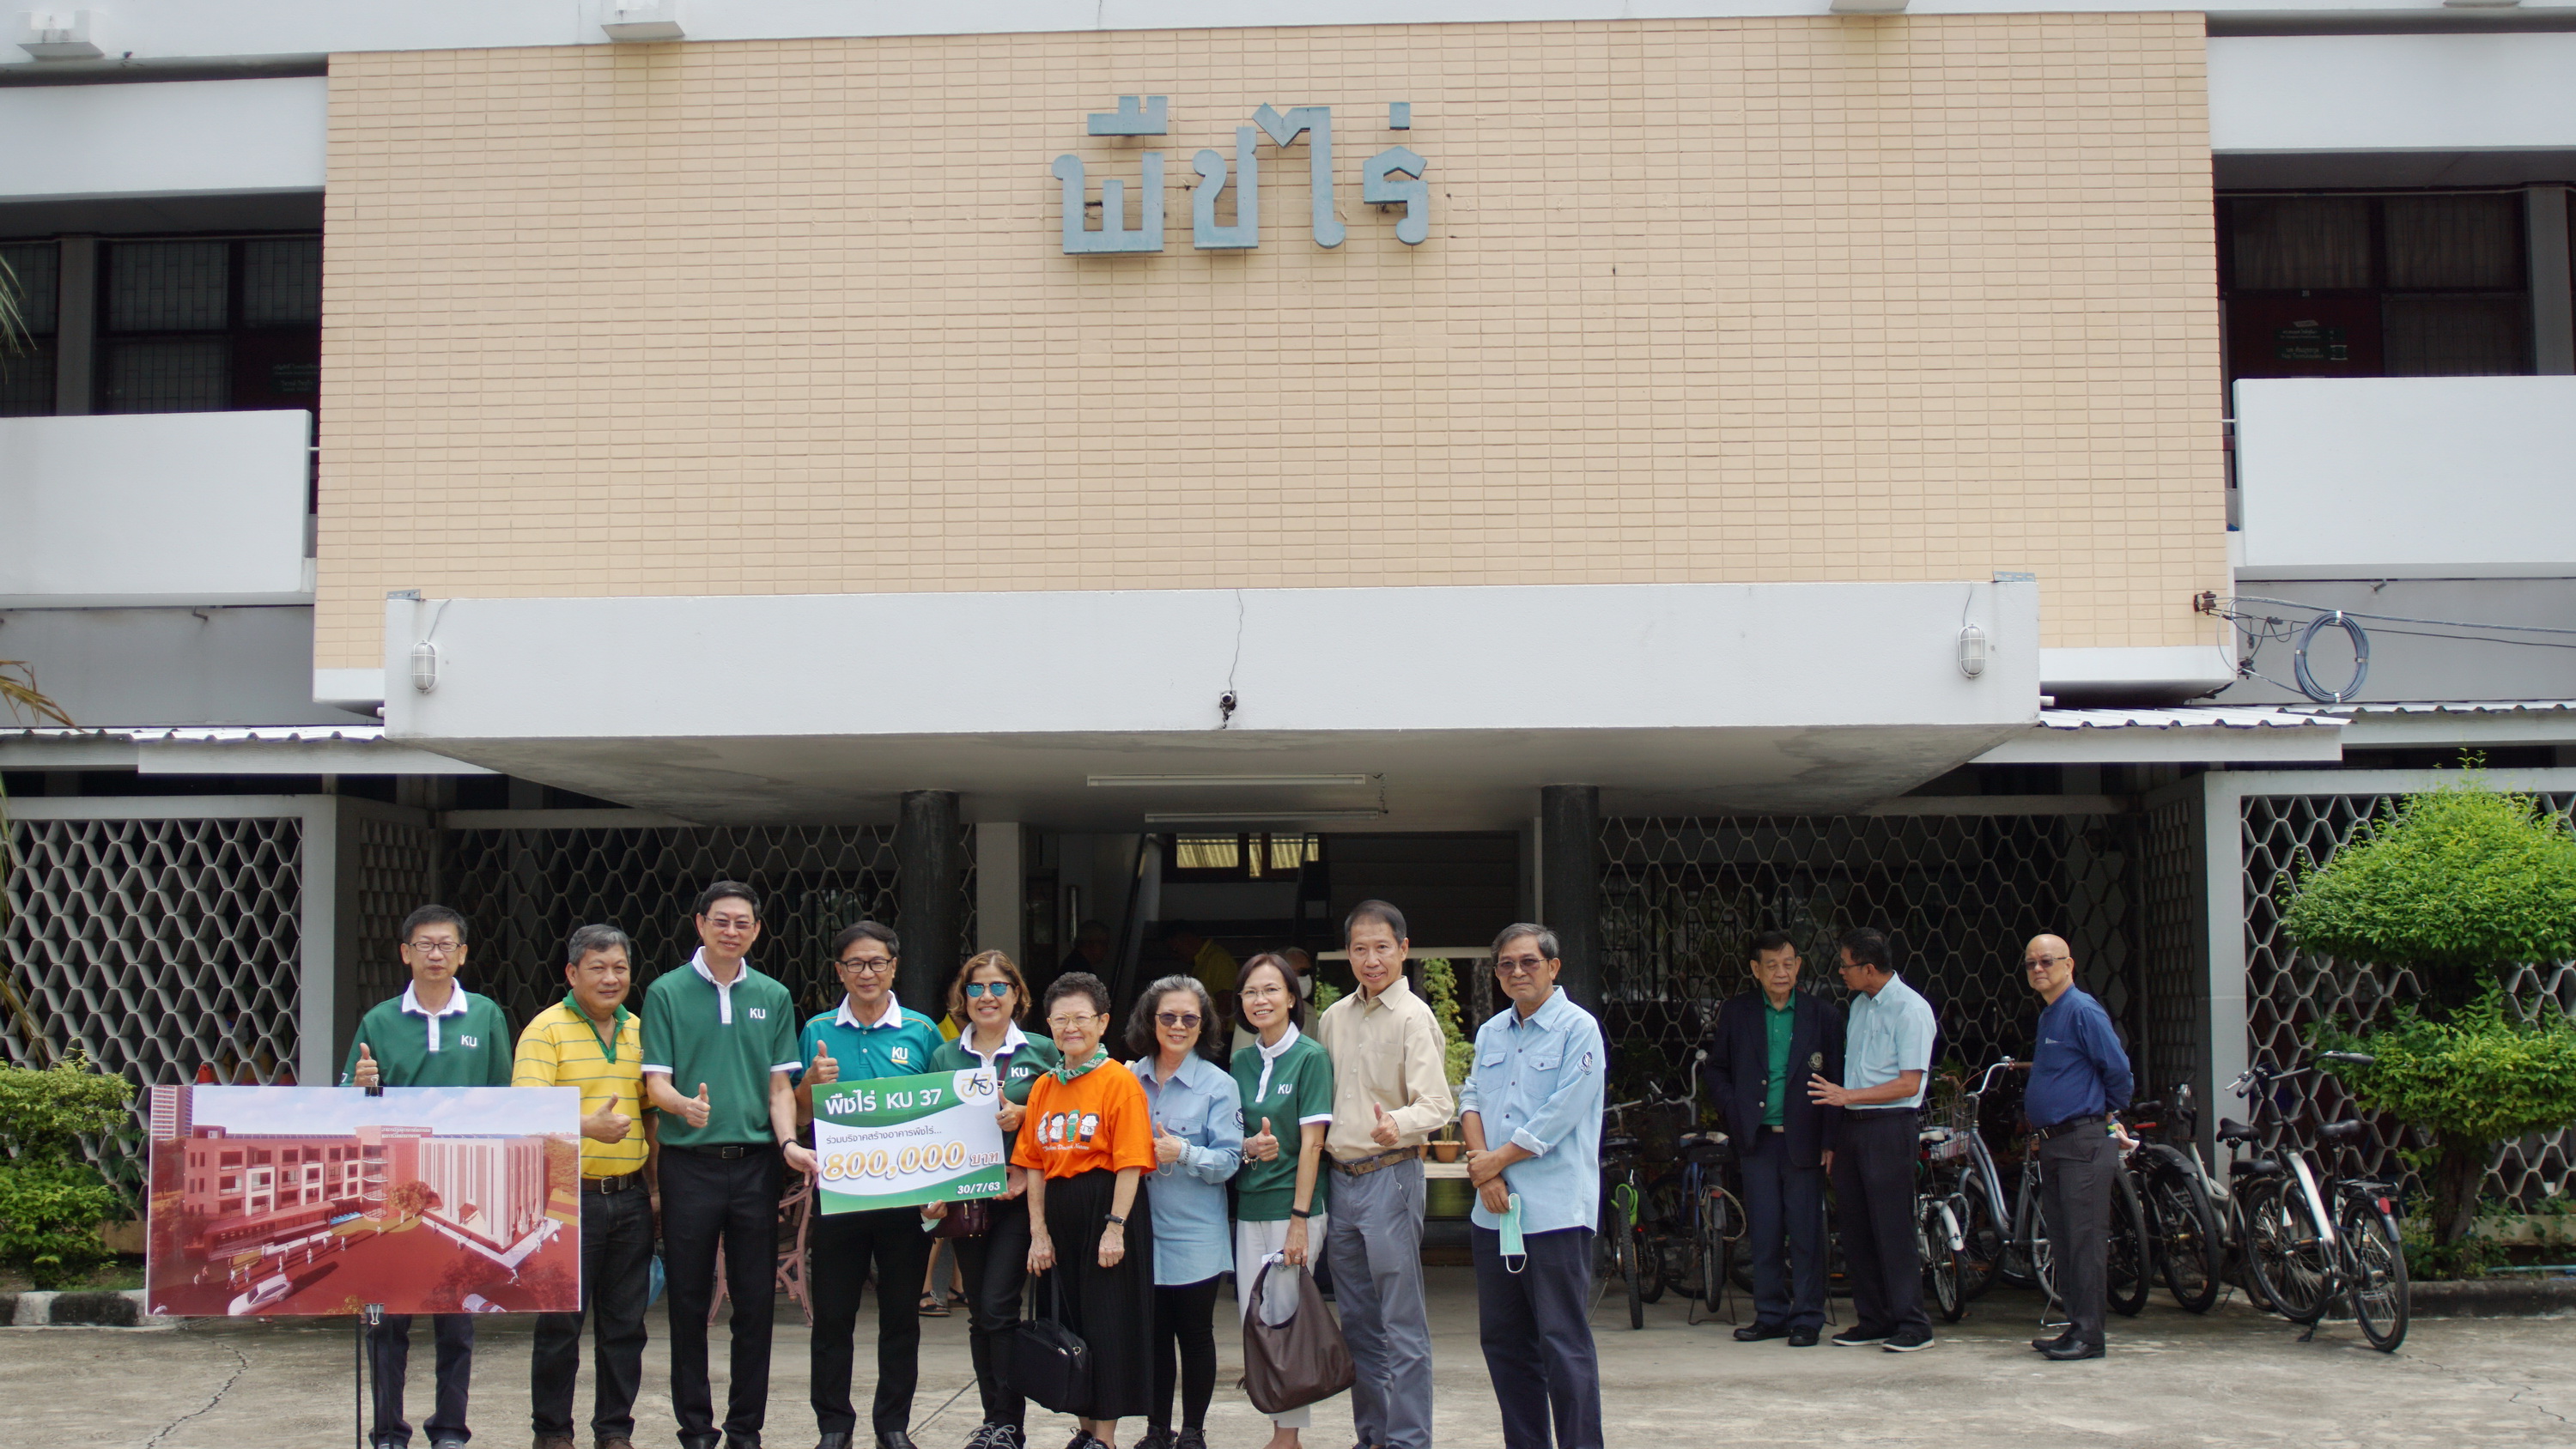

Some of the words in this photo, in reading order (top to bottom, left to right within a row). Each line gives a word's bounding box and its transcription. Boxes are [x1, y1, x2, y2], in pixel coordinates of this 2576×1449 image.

[1051, 94, 1430, 254] พืชไร่
[750, 1007, 766, 1019] KU
[461, 1034, 477, 1047] KU
[891, 1046, 908, 1060] KU
[1011, 1067, 1029, 1078] KU
[1277, 1083, 1293, 1094] KU
[824, 1089, 878, 1115] พืชไร่
[886, 1092, 914, 1109] KU
[920, 1088, 942, 1106] 37
[823, 1140, 967, 1180] 800,000
[970, 1150, 999, 1167] บาท
[957, 1181, 1001, 1195] 30/7/63
